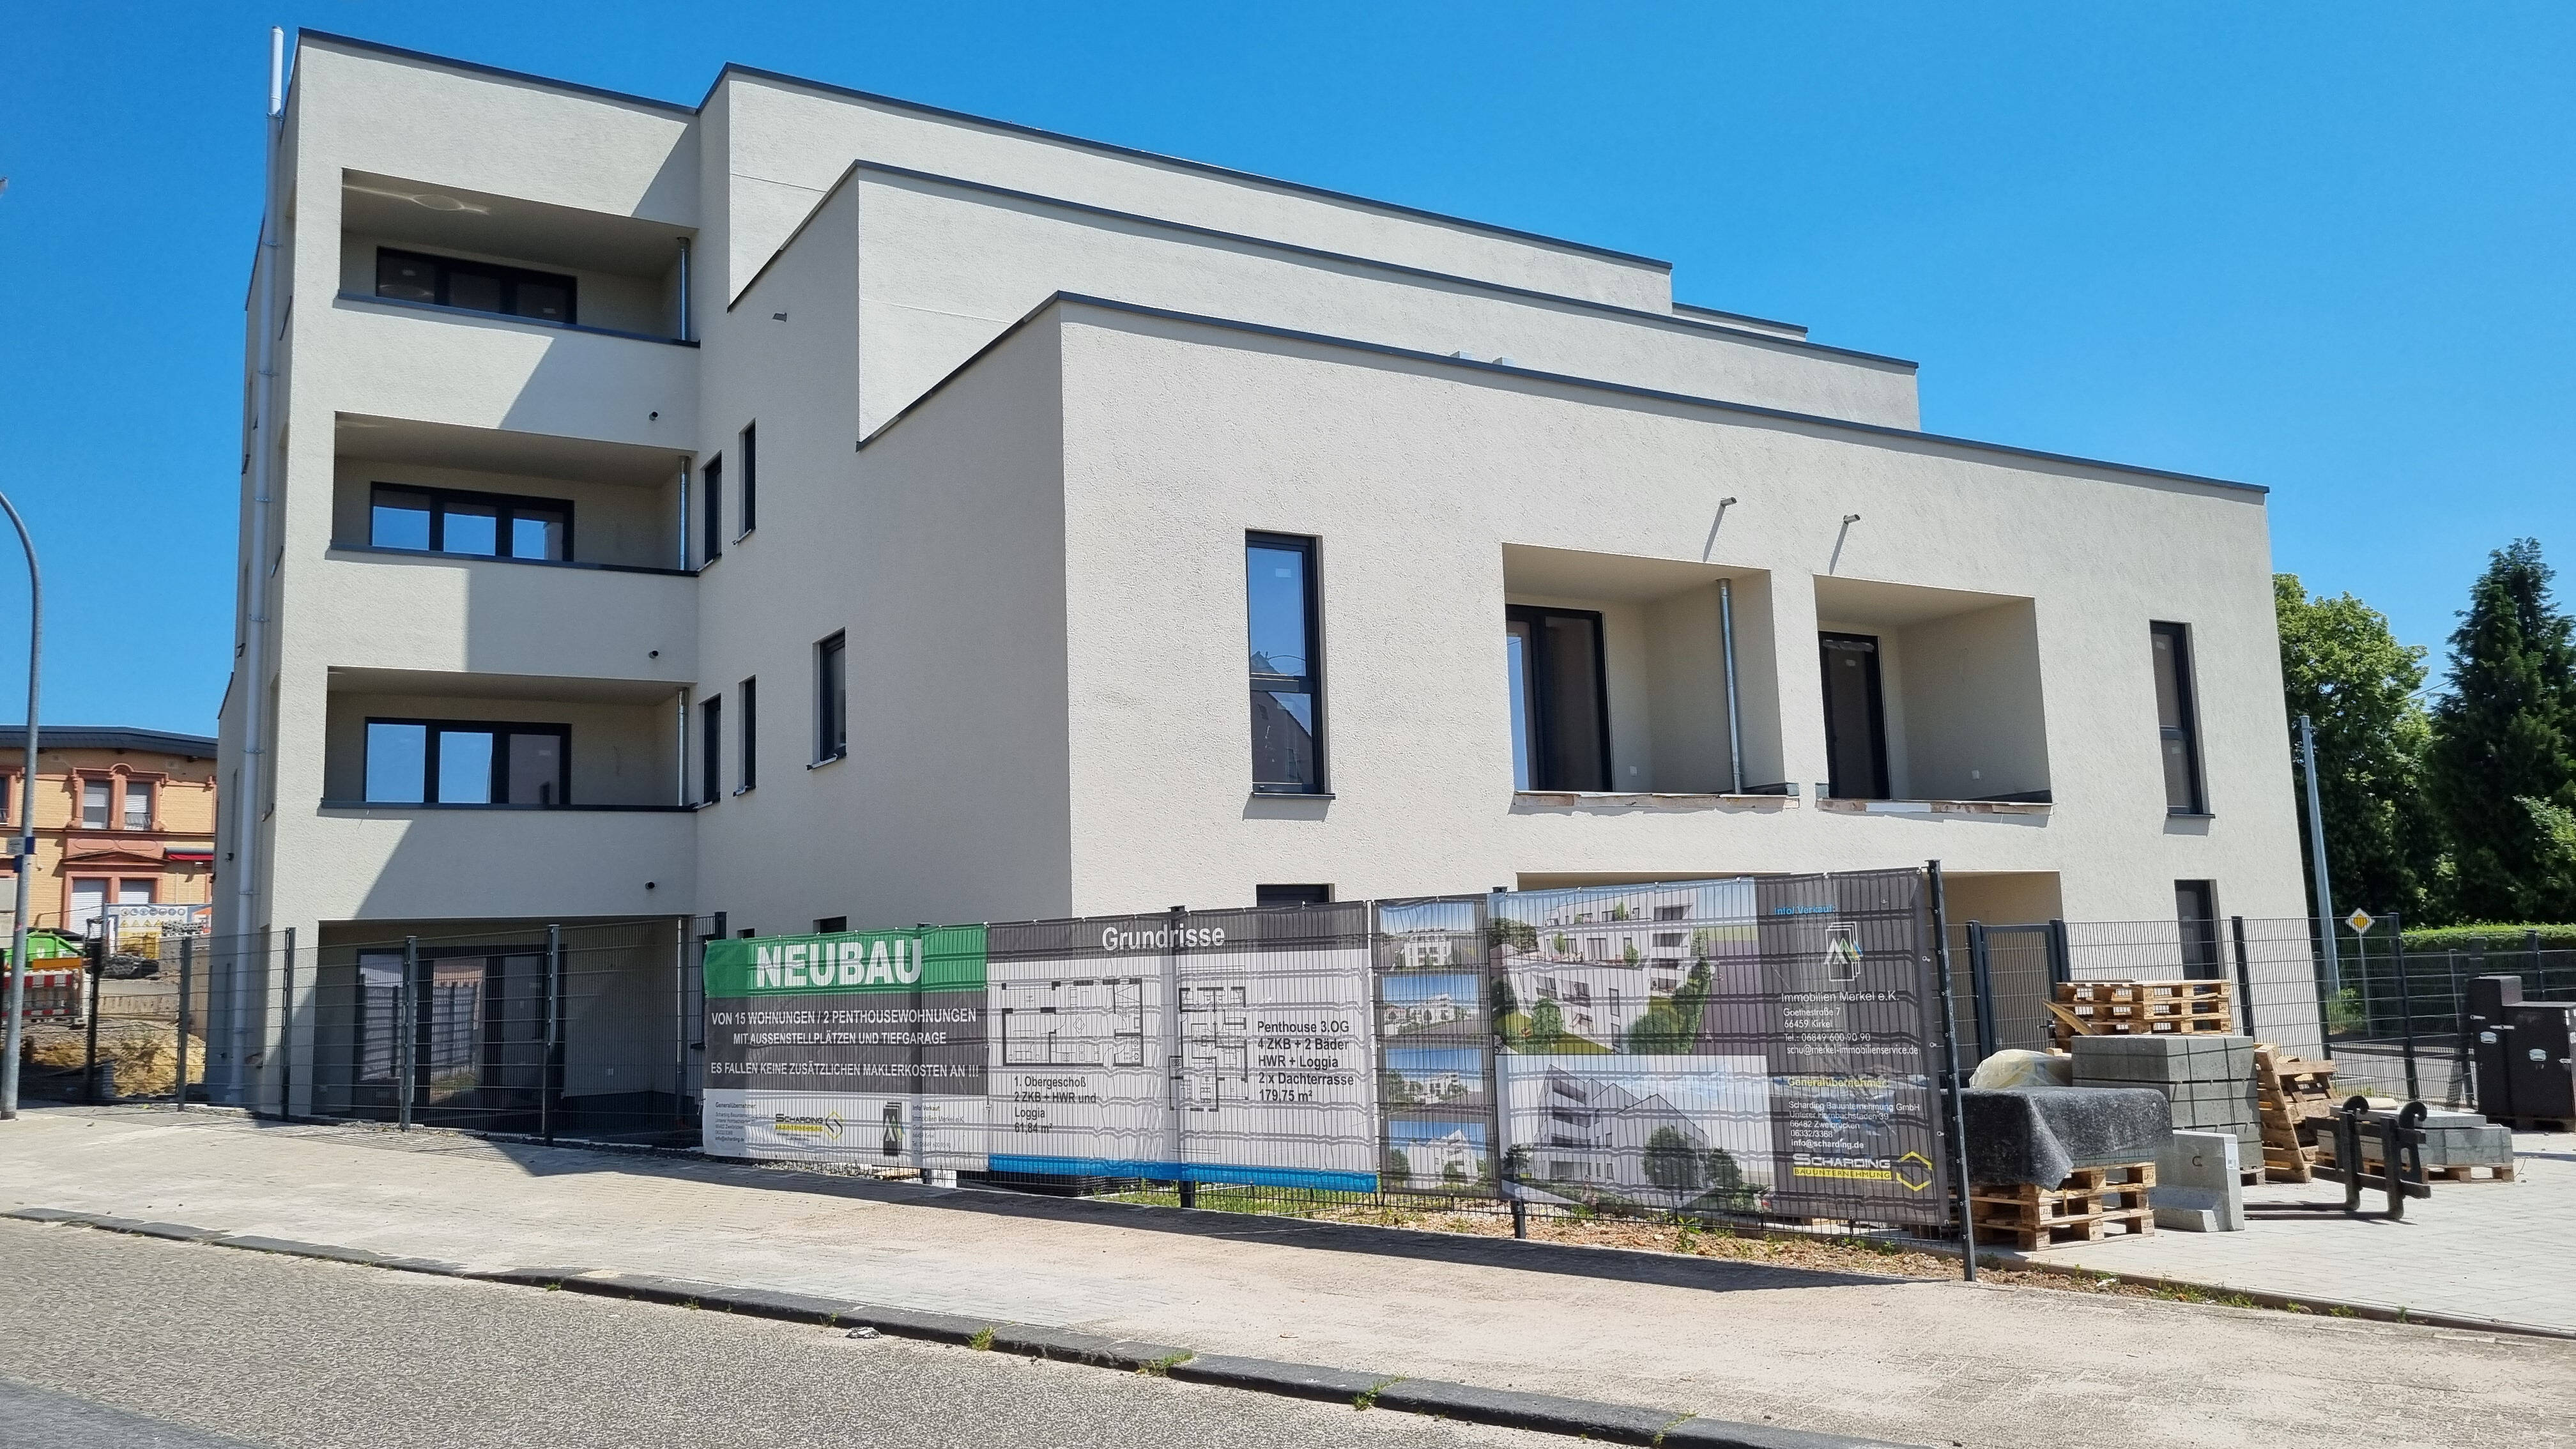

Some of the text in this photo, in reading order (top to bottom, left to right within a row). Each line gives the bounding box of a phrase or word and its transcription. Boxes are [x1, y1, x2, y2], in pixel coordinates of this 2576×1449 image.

[1102, 925, 1225, 951] Grundrisse
[756, 939, 922, 988] NEUBAU
[1781, 990, 1899, 1002] Immobilien Merkel e.K.
[712, 1008, 976, 1025] VON 15 WOHNUNGEN / 2 PENTHOUSEWOHNUNGEN
[1783, 1008, 1841, 1016] Goethestraße 7
[1257, 1020, 1349, 1032] Penthouse 3.OG
[1784, 1019, 1832, 1028] 66459 Kirkel
[733, 1030, 947, 1045] MIT AUSSENSTELLPLÄTZEN UND TIEFGARAGE
[1257, 1038, 1349, 1050] 4 ZKB + 2 Bäder
[1786, 1043, 1919, 1055] schu@merkel-immobilienservice.de
[711, 1060, 979, 1077] ES FALLEN KEINE ZUSÄTZLICHEN MAKLERKOSTEN AN !!!
[1259, 1055, 1338, 1070] HWR + Loggia
[1015, 1076, 1087, 1090] 1. Obergeschoß
[1258, 1071, 1354, 1085] 2 x Dachterrasse
[1014, 1091, 1020, 1102] 2
[1022, 1091, 1041, 1102] ZKB
[1052, 1092, 1076, 1103] HWR
[1078, 1092, 1096, 1103] und
[1259, 1089, 1312, 1103] 179,75 m²
[1788, 1101, 1920, 1112] Scharding Bauunternehmung GmbH
[776, 1114, 823, 1124] SCHARDING
[1015, 1107, 1045, 1120] Loggia
[1015, 1123, 1038, 1135] 61,84
[1791, 1139, 1864, 1149] info@scharding.de
[1793, 1153, 1891, 1169] SCHARDING
[1795, 1169, 1890, 1179] BAUUNTERNEHMUNG
